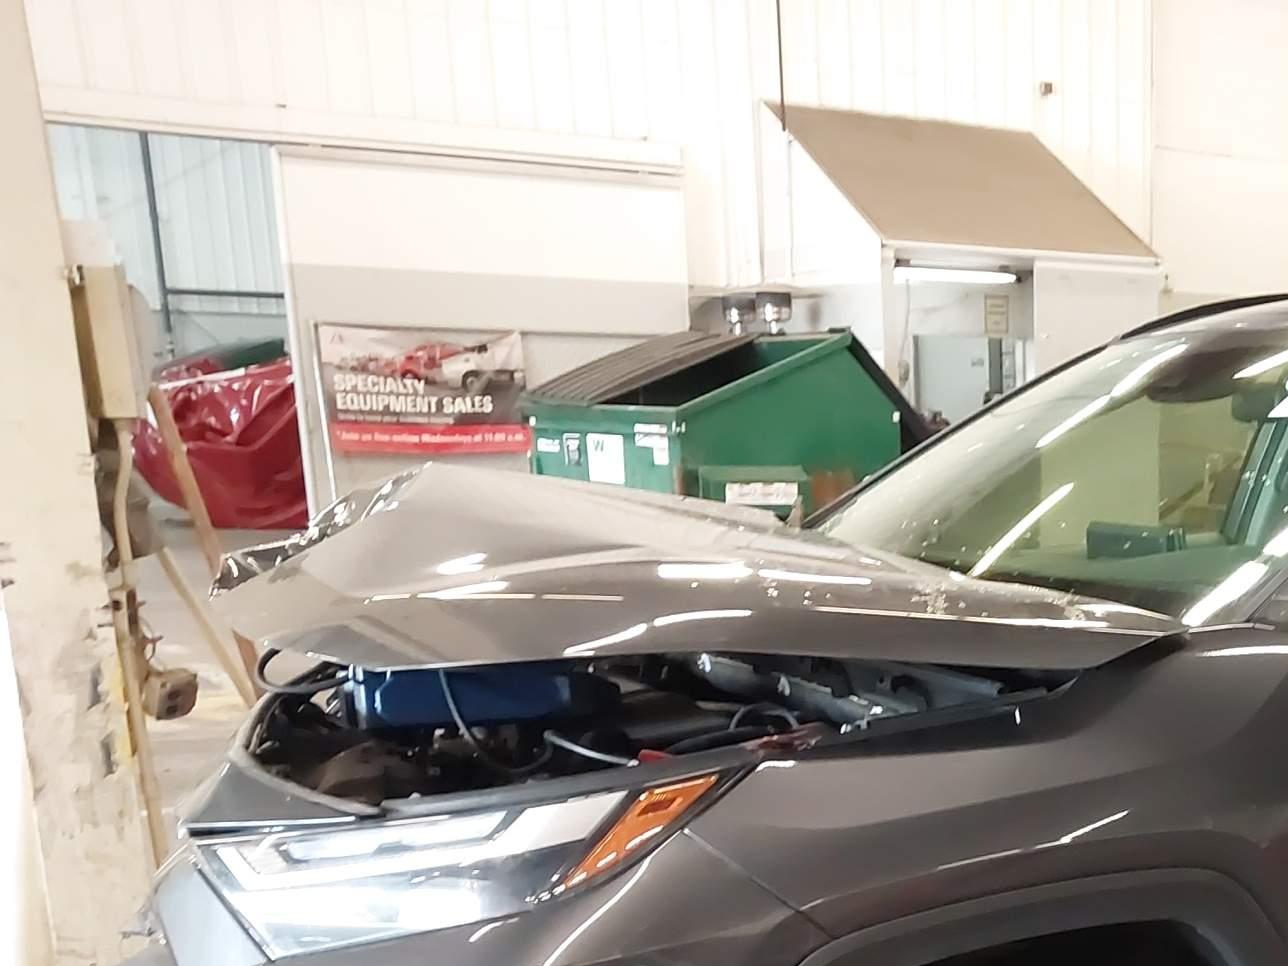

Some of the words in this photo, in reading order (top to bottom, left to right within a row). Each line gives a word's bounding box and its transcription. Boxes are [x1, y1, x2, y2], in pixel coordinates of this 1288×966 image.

[333, 373, 425, 395] SPECIALTY
[336, 391, 438, 413] EQUIPMENT
[443, 395, 493, 413] SALES
